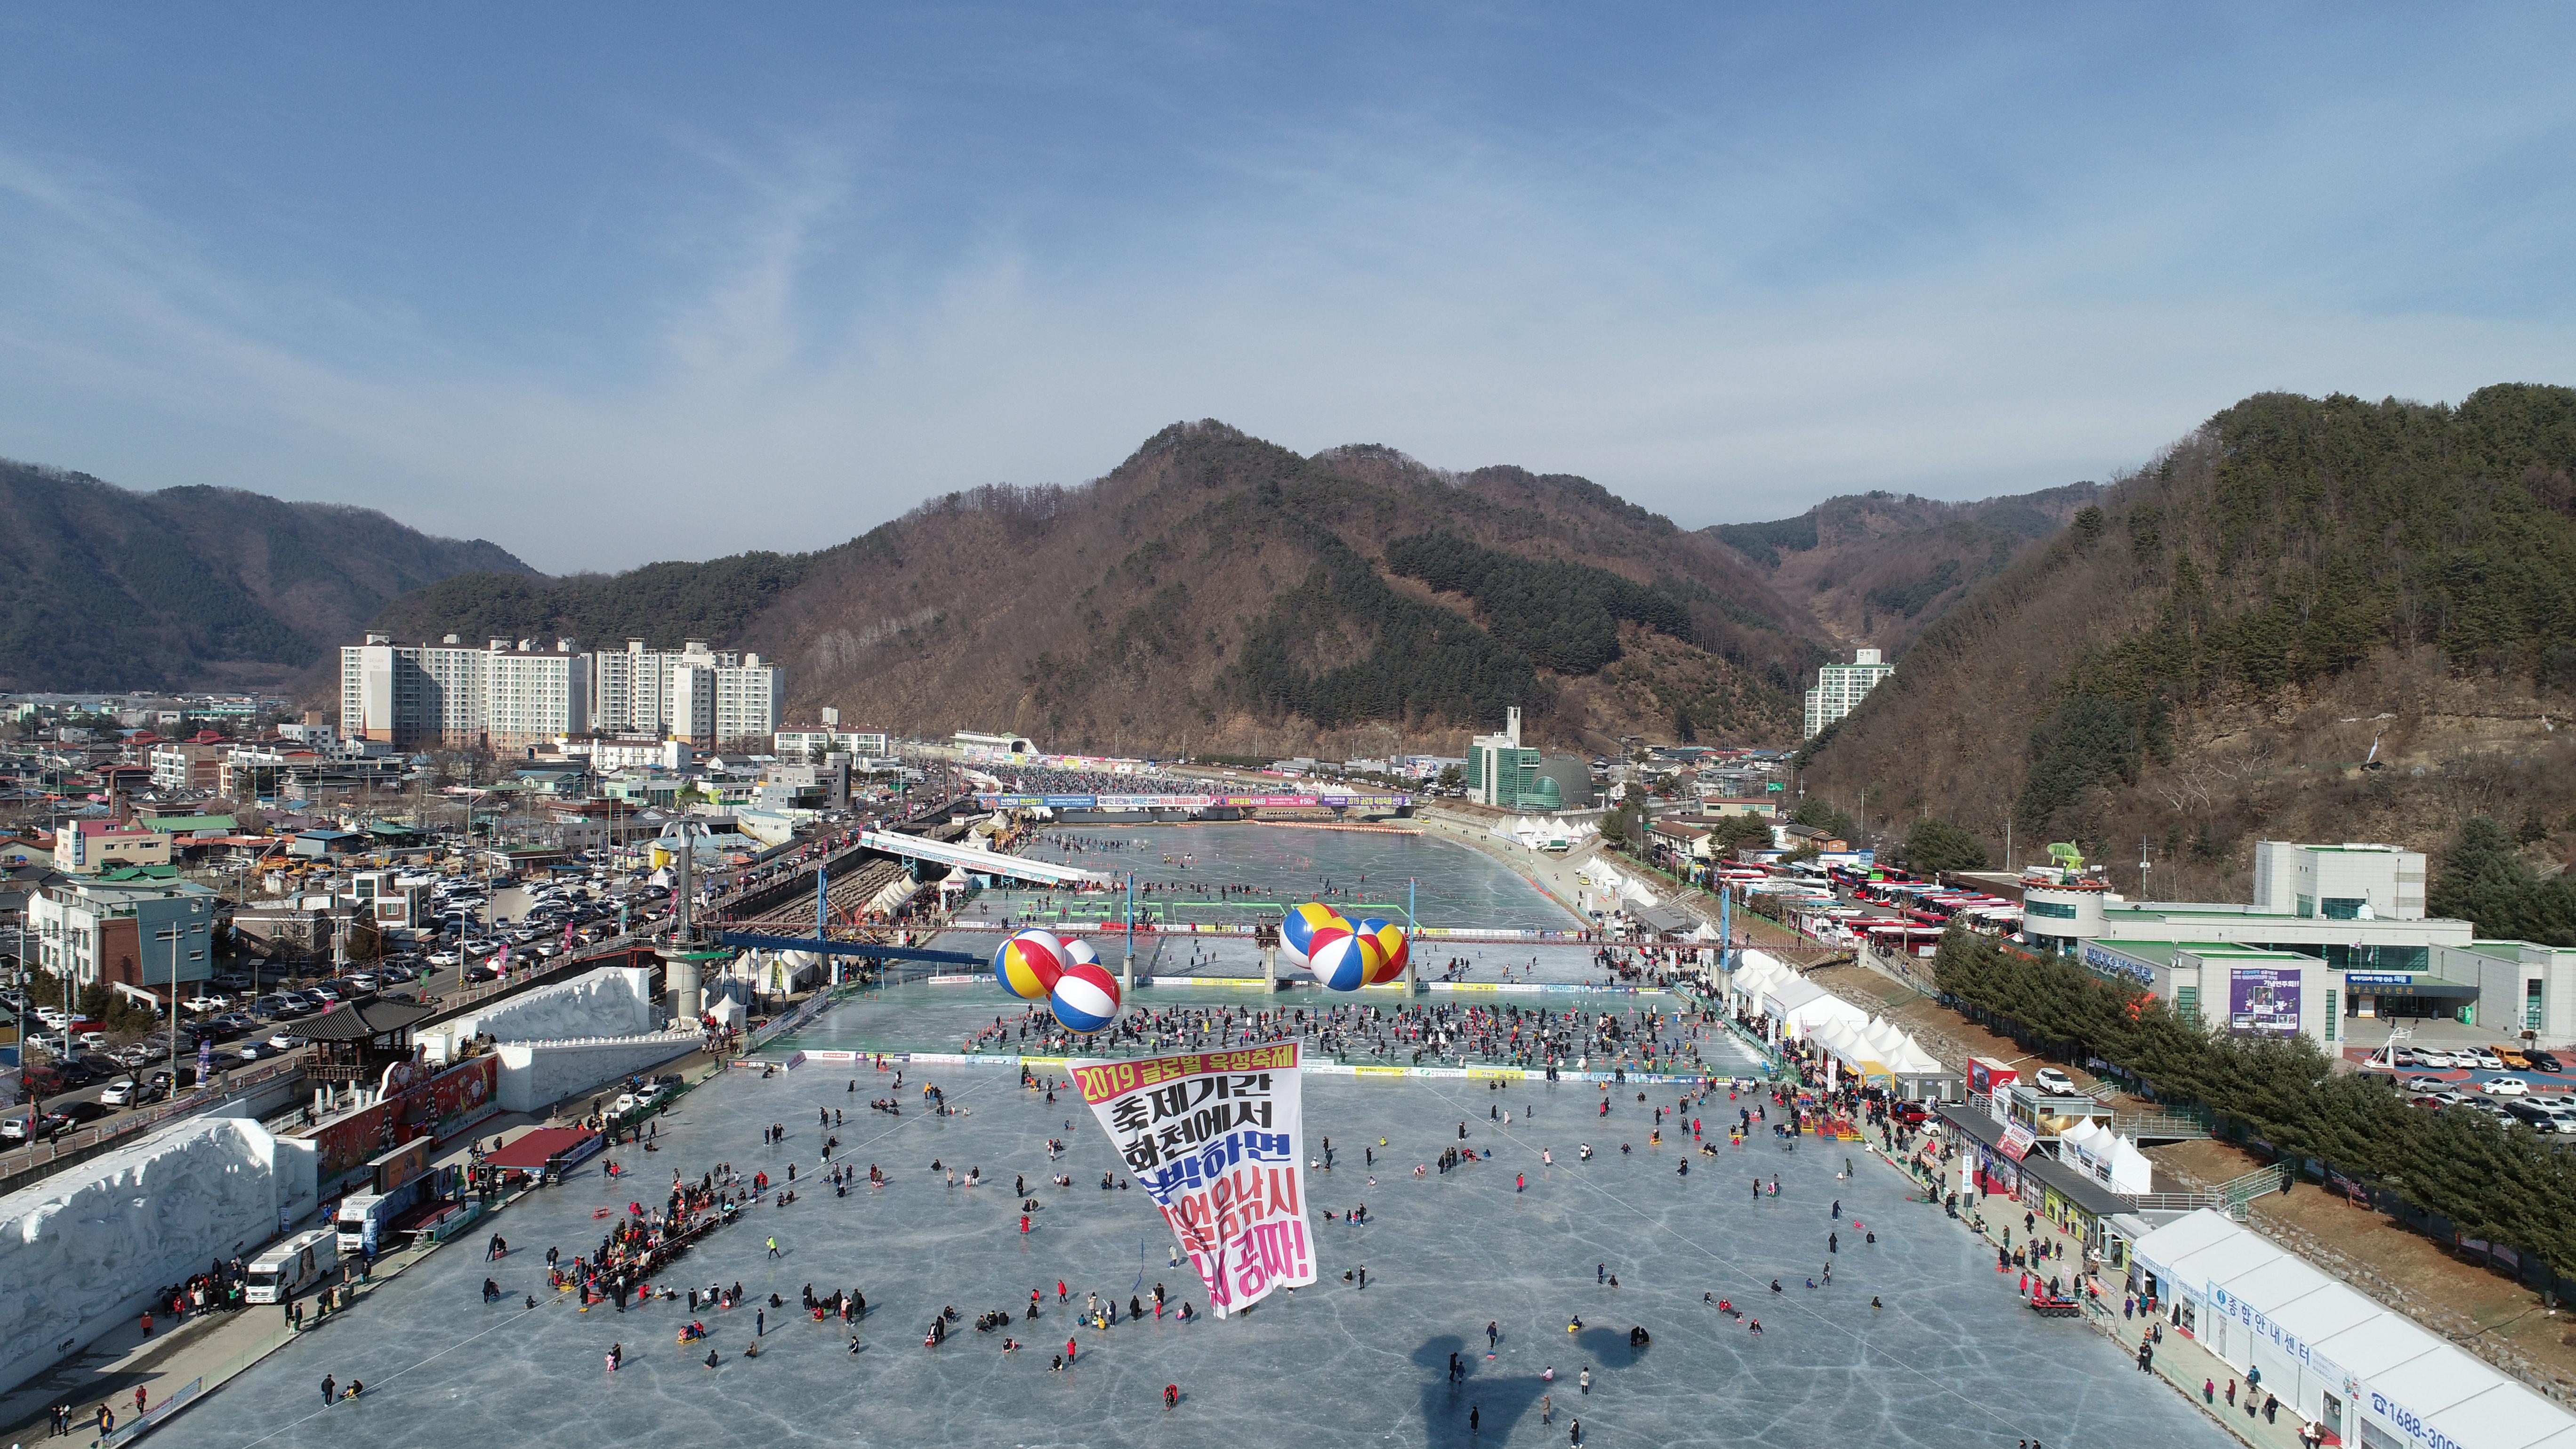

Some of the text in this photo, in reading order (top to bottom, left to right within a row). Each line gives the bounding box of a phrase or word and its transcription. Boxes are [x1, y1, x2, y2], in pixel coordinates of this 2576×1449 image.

[1114, 797, 1130, 805] 화천에서
[1131, 797, 1148, 805] 숙박하면
[1347, 797, 1402, 805] 2019 글로벌 육성축제 선정
[1076, 1045, 1294, 1101] 2019 글로벌 육성축제
[1112, 1073, 1273, 1134] 축제기간
[1122, 1101, 1272, 1173] 화천에서
[2228, 1296, 2310, 1366] 종합안내센터
